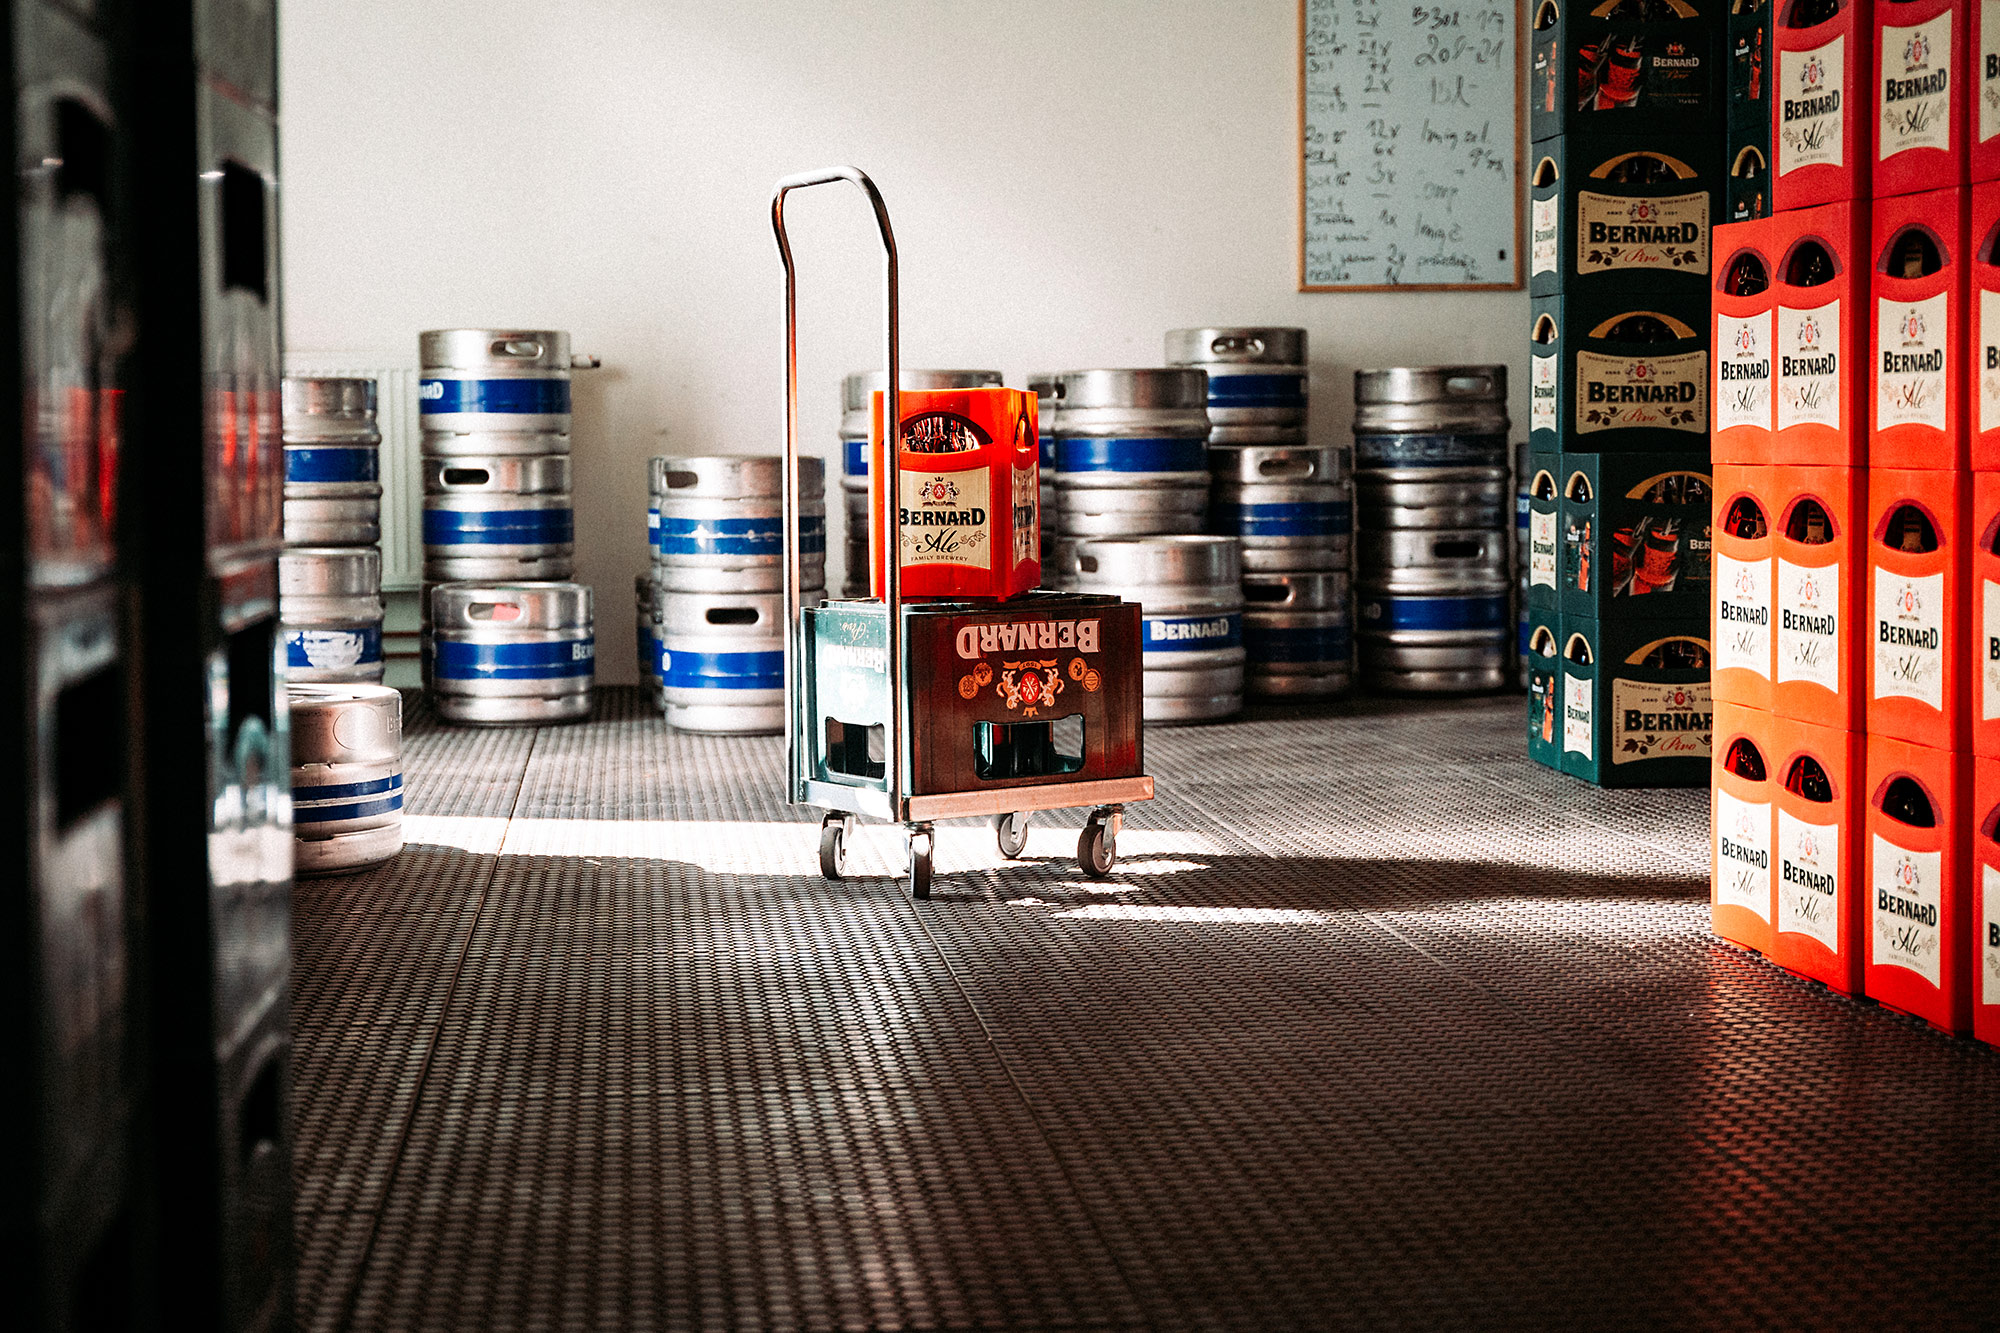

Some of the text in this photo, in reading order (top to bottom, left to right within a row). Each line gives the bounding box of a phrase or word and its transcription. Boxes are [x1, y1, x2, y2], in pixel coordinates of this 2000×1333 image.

[1653, 56, 1700, 67] BERNARD
[1885, 68, 1947, 103] BERNARD
[1784, 89, 1840, 123] BERNARD
[1900, 101, 1930, 135] Ale
[1797, 119, 1825, 153] Ale
[1589, 222, 1699, 244] BERNARD
[1624, 246, 1660, 263] Pivo
[1721, 359, 1770, 381] BERNARD
[1782, 353, 1836, 377] BERNARD
[1883, 349, 1943, 373] BERNARD
[1588, 381, 1696, 403] BERNARD
[1732, 384, 1756, 412] Ale
[1795, 379, 1822, 410] Ale
[1897, 376, 1927, 410] Ale
[1622, 406, 1658, 423] Pivo
[900, 508, 986, 526] BERNARD
[915, 527, 960, 553] Ale
[1721, 600, 1768, 626] BERNARD
[1783, 608, 1835, 636] BERNARD
[956, 619, 1100, 660] BERNARD
[1150, 618, 1229, 641] BERNARD
[1732, 629, 1755, 657] Ale
[1879, 620, 1939, 650] BERNARD
[1795, 639, 1821, 667] Ale
[1893, 652, 1922, 684] Ale
[1624, 710, 1711, 731] BERNAR
[1660, 734, 1697, 751] Pivo
[1721, 836, 1768, 870] BERNARD
[1732, 869, 1756, 897] Ale
[1783, 859, 1835, 896] BERNARD
[1795, 894, 1821, 924] Ale
[1878, 887, 1937, 927] BERNARD
[1892, 923, 1921, 957] Ale
